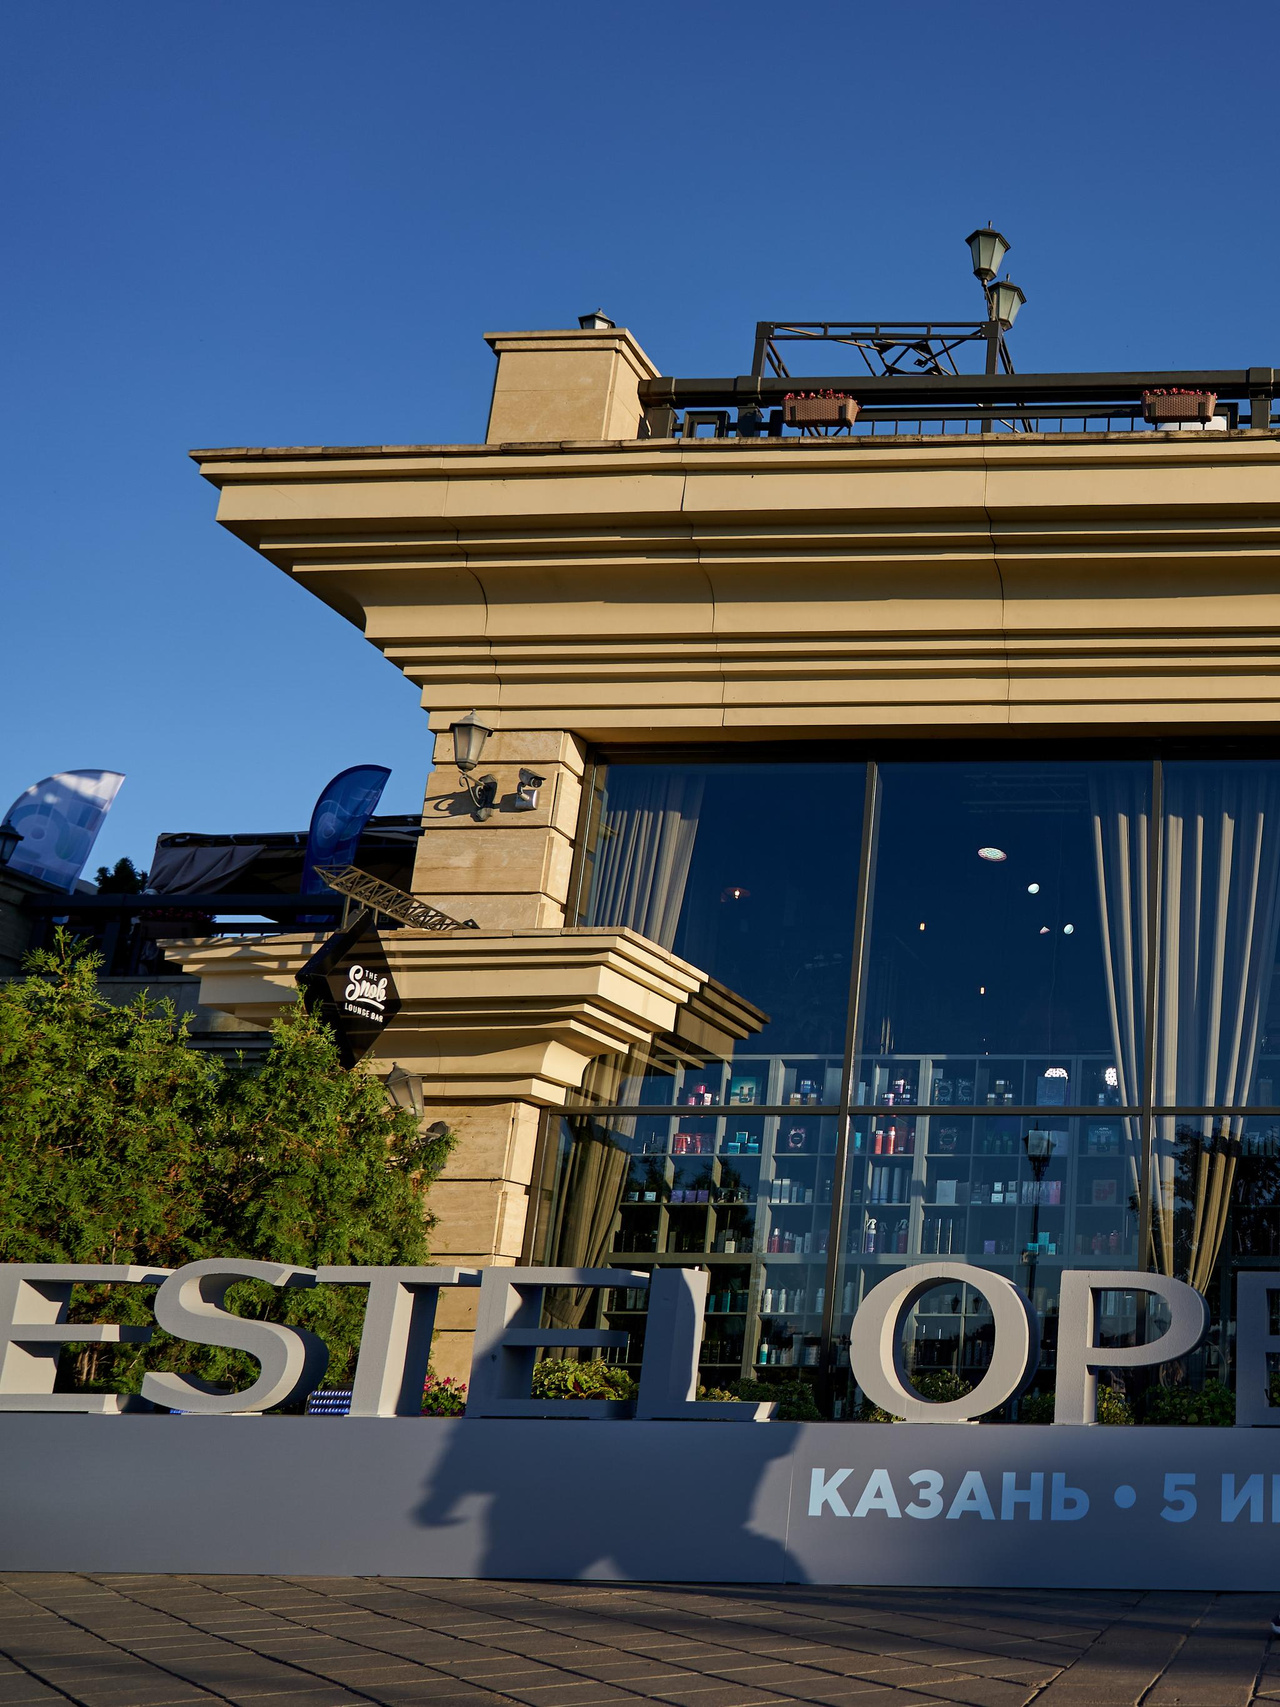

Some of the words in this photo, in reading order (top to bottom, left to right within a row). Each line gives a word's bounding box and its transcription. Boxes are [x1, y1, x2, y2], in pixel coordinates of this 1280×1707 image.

[345, 965, 388, 1002] Snob
[365, 969, 378, 981] THE
[344, 1002, 370, 1018] LOUNGE
[370, 1012, 384, 1023] BAR
[0, 1257, 779, 1421] ESTEL
[807, 1466, 1090, 1521] КАЗАНЬ
[1159, 1472, 1198, 1524] 5
